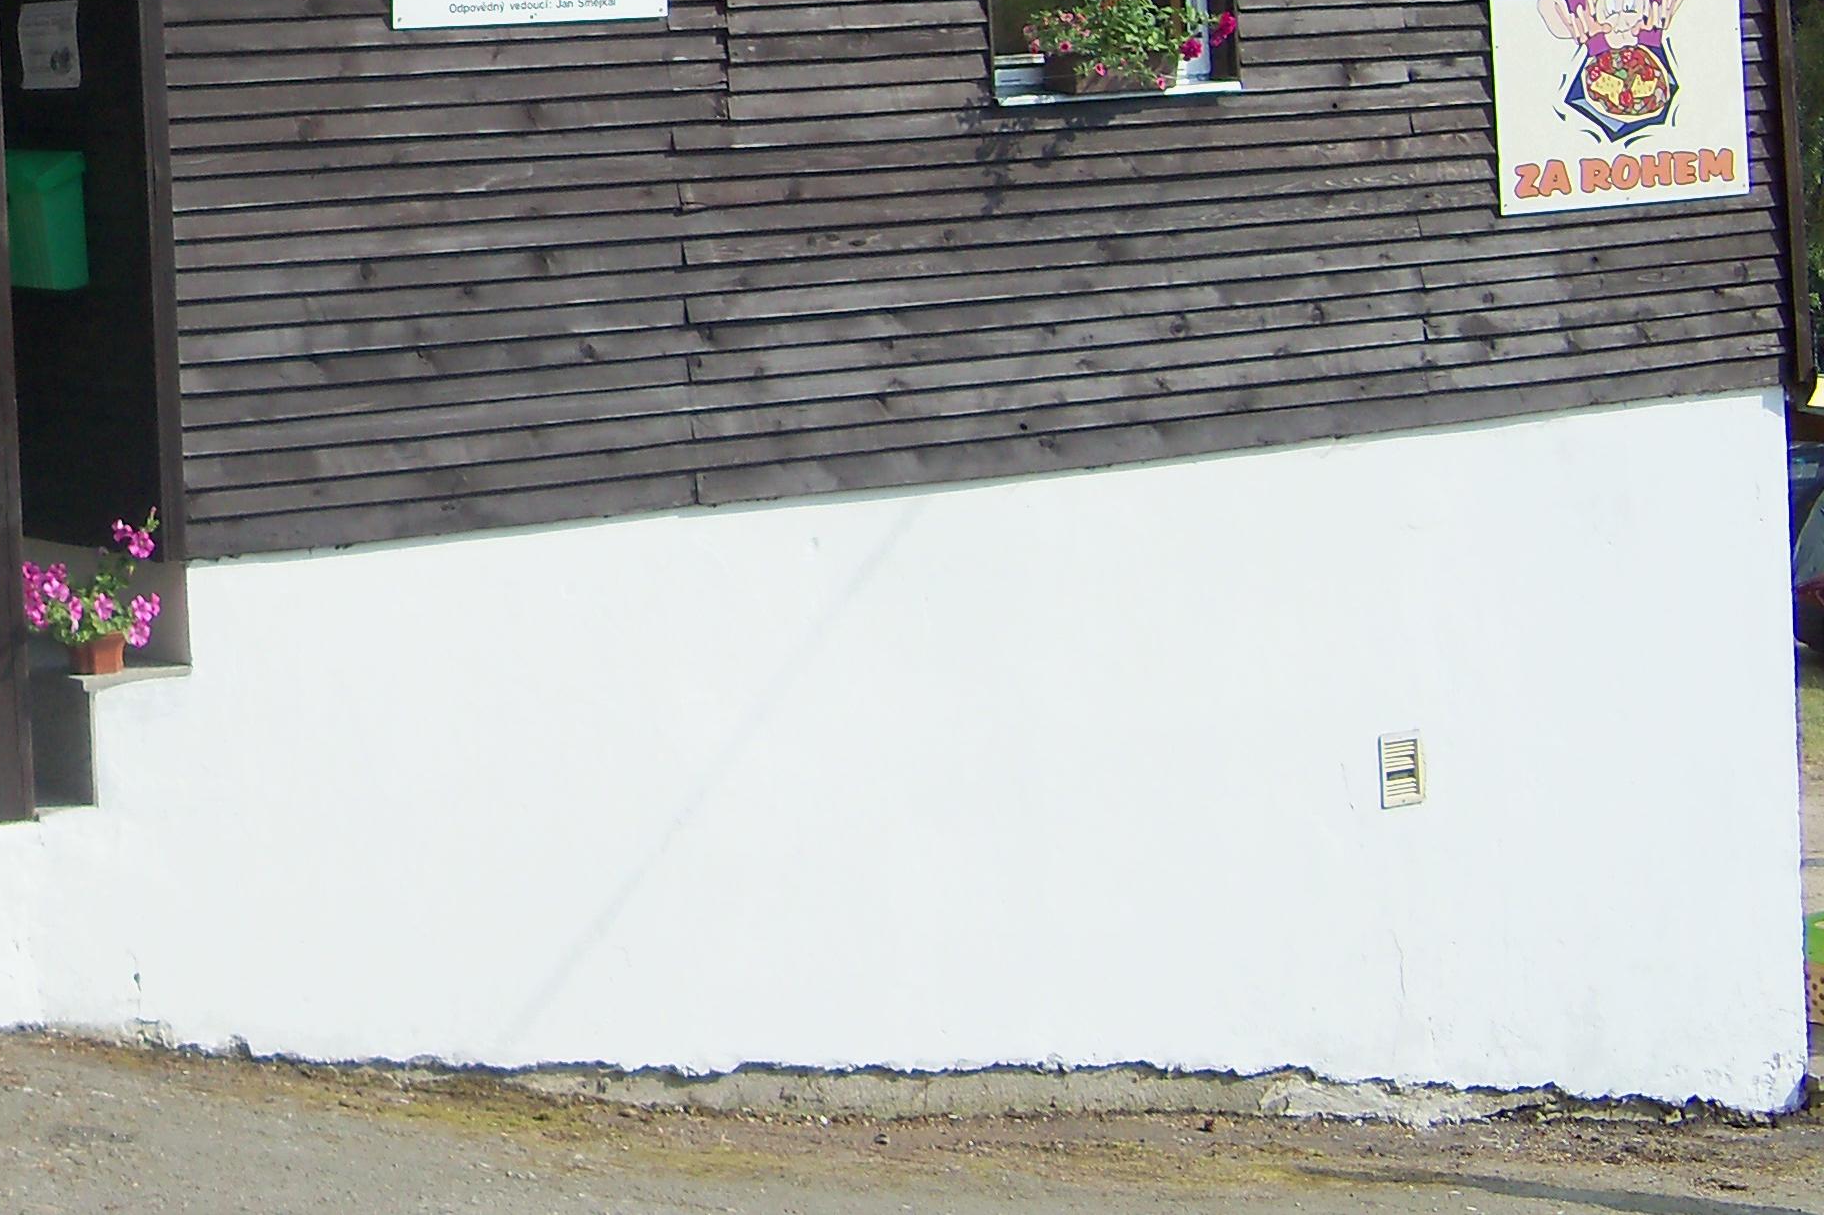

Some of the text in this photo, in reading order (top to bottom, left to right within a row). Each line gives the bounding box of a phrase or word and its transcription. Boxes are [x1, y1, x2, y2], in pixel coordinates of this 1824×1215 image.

[449, 1, 505, 14] Odpovědný
[1514, 147, 1734, 199] ZA ROHEM
